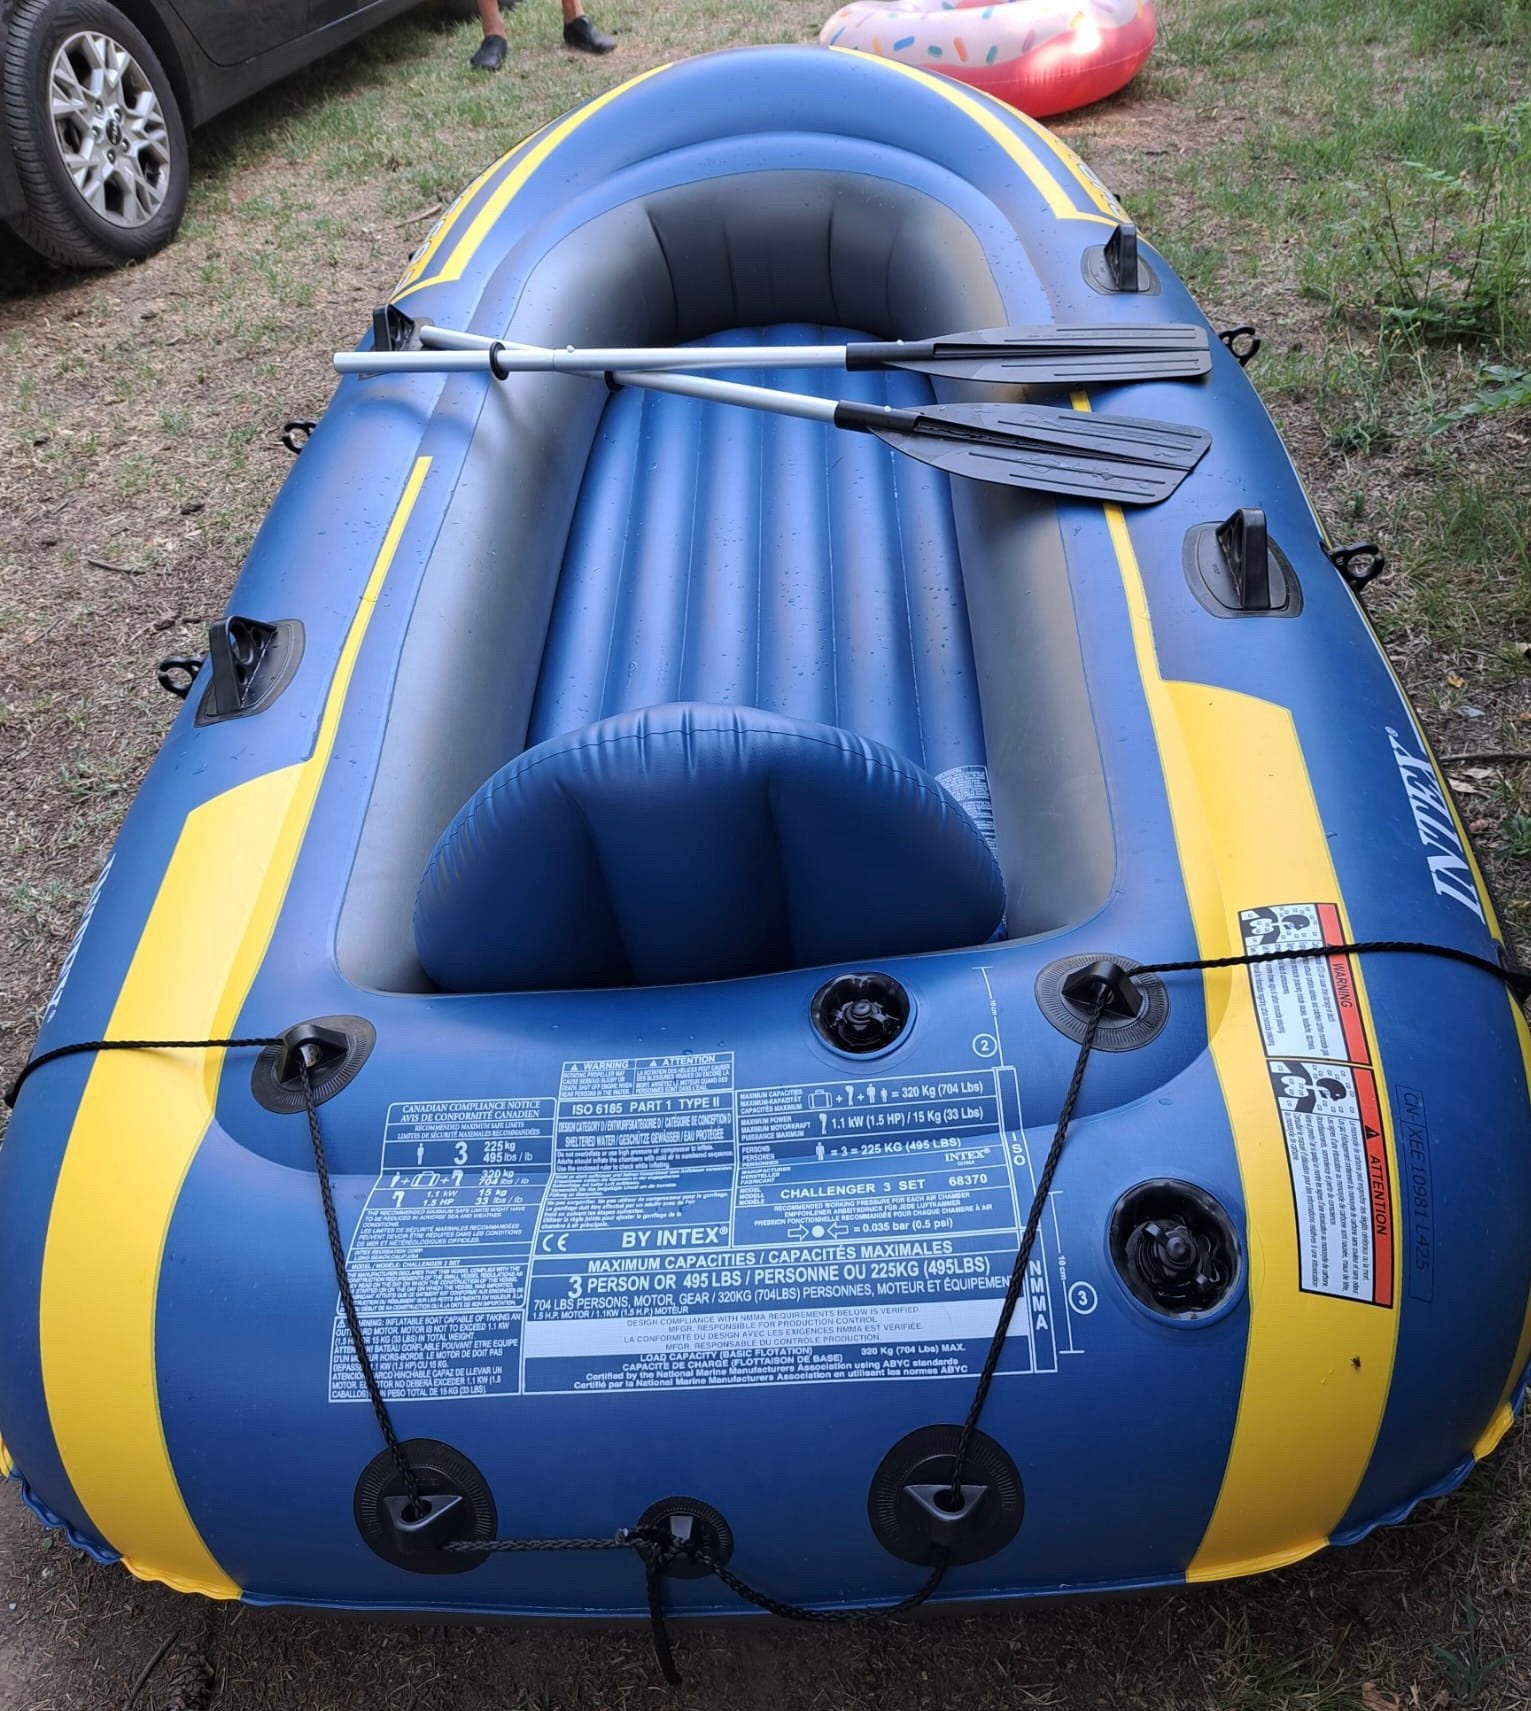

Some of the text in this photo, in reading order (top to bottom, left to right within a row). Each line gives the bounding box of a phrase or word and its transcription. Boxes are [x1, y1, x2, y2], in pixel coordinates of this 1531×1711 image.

[1332, 962, 1353, 1008] WARNING
[981, 1040, 989, 1050] 2
[584, 1061, 628, 1070] WARNING
[663, 1055, 715, 1065] ATTENTION
[902, 1081, 983, 1098] 320 Kg (704 Lbs)
[403, 1101, 540, 1113] CANADIAN COMPLIANCE NOTICE
[572, 1104, 593, 1115] ISO
[596, 1102, 622, 1114] 6185
[630, 1100, 662, 1112] PART
[666, 1100, 671, 1110] 1
[679, 1097, 710, 1109] TYPE
[401, 1110, 539, 1122] AVIS DE CONFORMITÉ CANADIEN
[832, 1107, 983, 1129] 1.1 kW (1.5 HP) 15 Kg (33 Lbs)
[454, 1142, 467, 1165] 3
[484, 1141, 515, 1152] 225 kg
[841, 1138, 961, 1156] 3 225 KG (495 LBS)
[1012, 1132, 1026, 1166] ISO
[483, 1152, 533, 1163] 495 lbs lb
[482, 1170, 514, 1178] 320 kg
[495, 1189, 507, 1197] kg
[780, 1174, 987, 1199] CHALLENGER 3 SET 68370
[1369, 1154, 1388, 1236] ATTENTION
[863, 1218, 953, 1232] 0.035 bar (0.5 psi)
[622, 1231, 651, 1248] BY
[588, 1241, 952, 1273] MAXIMUM CAPACITIES CAPACITÉS MAXIMALES
[568, 1256, 990, 1299] 3 PERSON OR 495 LBS PERSONNE OU 225KG (495LBS)
[534, 1299, 550, 1310] 704
[554, 1298, 573, 1309] LBS
[577, 1296, 630, 1310] PERSONS,
[634, 1294, 675, 1307] MOTOR,
[679, 1292, 709, 1304] GEAR
[718, 1290, 751, 1302] 320KG
[754, 1287, 800, 1304] (704LBS)
[803, 1284, 874, 1299] PERSONNES,
[878, 1281, 924, 1294] MOTEUR
[928, 1280, 941, 1291] ET
[1029, 1260, 1048, 1330] NMMA
[1078, 1290, 1087, 1305] 3
[386, 1318, 423, 1326] INFLATABLE
[486, 1314, 510, 1322] TAKING
[533, 1312, 543, 1320] 1.5
[561, 1310, 589, 1318] MOTOR
[596, 1309, 619, 1317] 1.1KW
[621, 1308, 634, 1317] (1.5
[636, 1308, 653, 1317] H.P.)
[660, 1317, 715, 1325] COMPLIANCE
[640, 1353, 666, 1362] LOAD
[669, 1351, 716, 1360] CAPACITY
[719, 1349, 750, 1358] (BASIC
[881, 1347, 893, 1356] Kg
[896, 1347, 916, 1355] (704
[941, 1344, 966, 1352] MAX.
